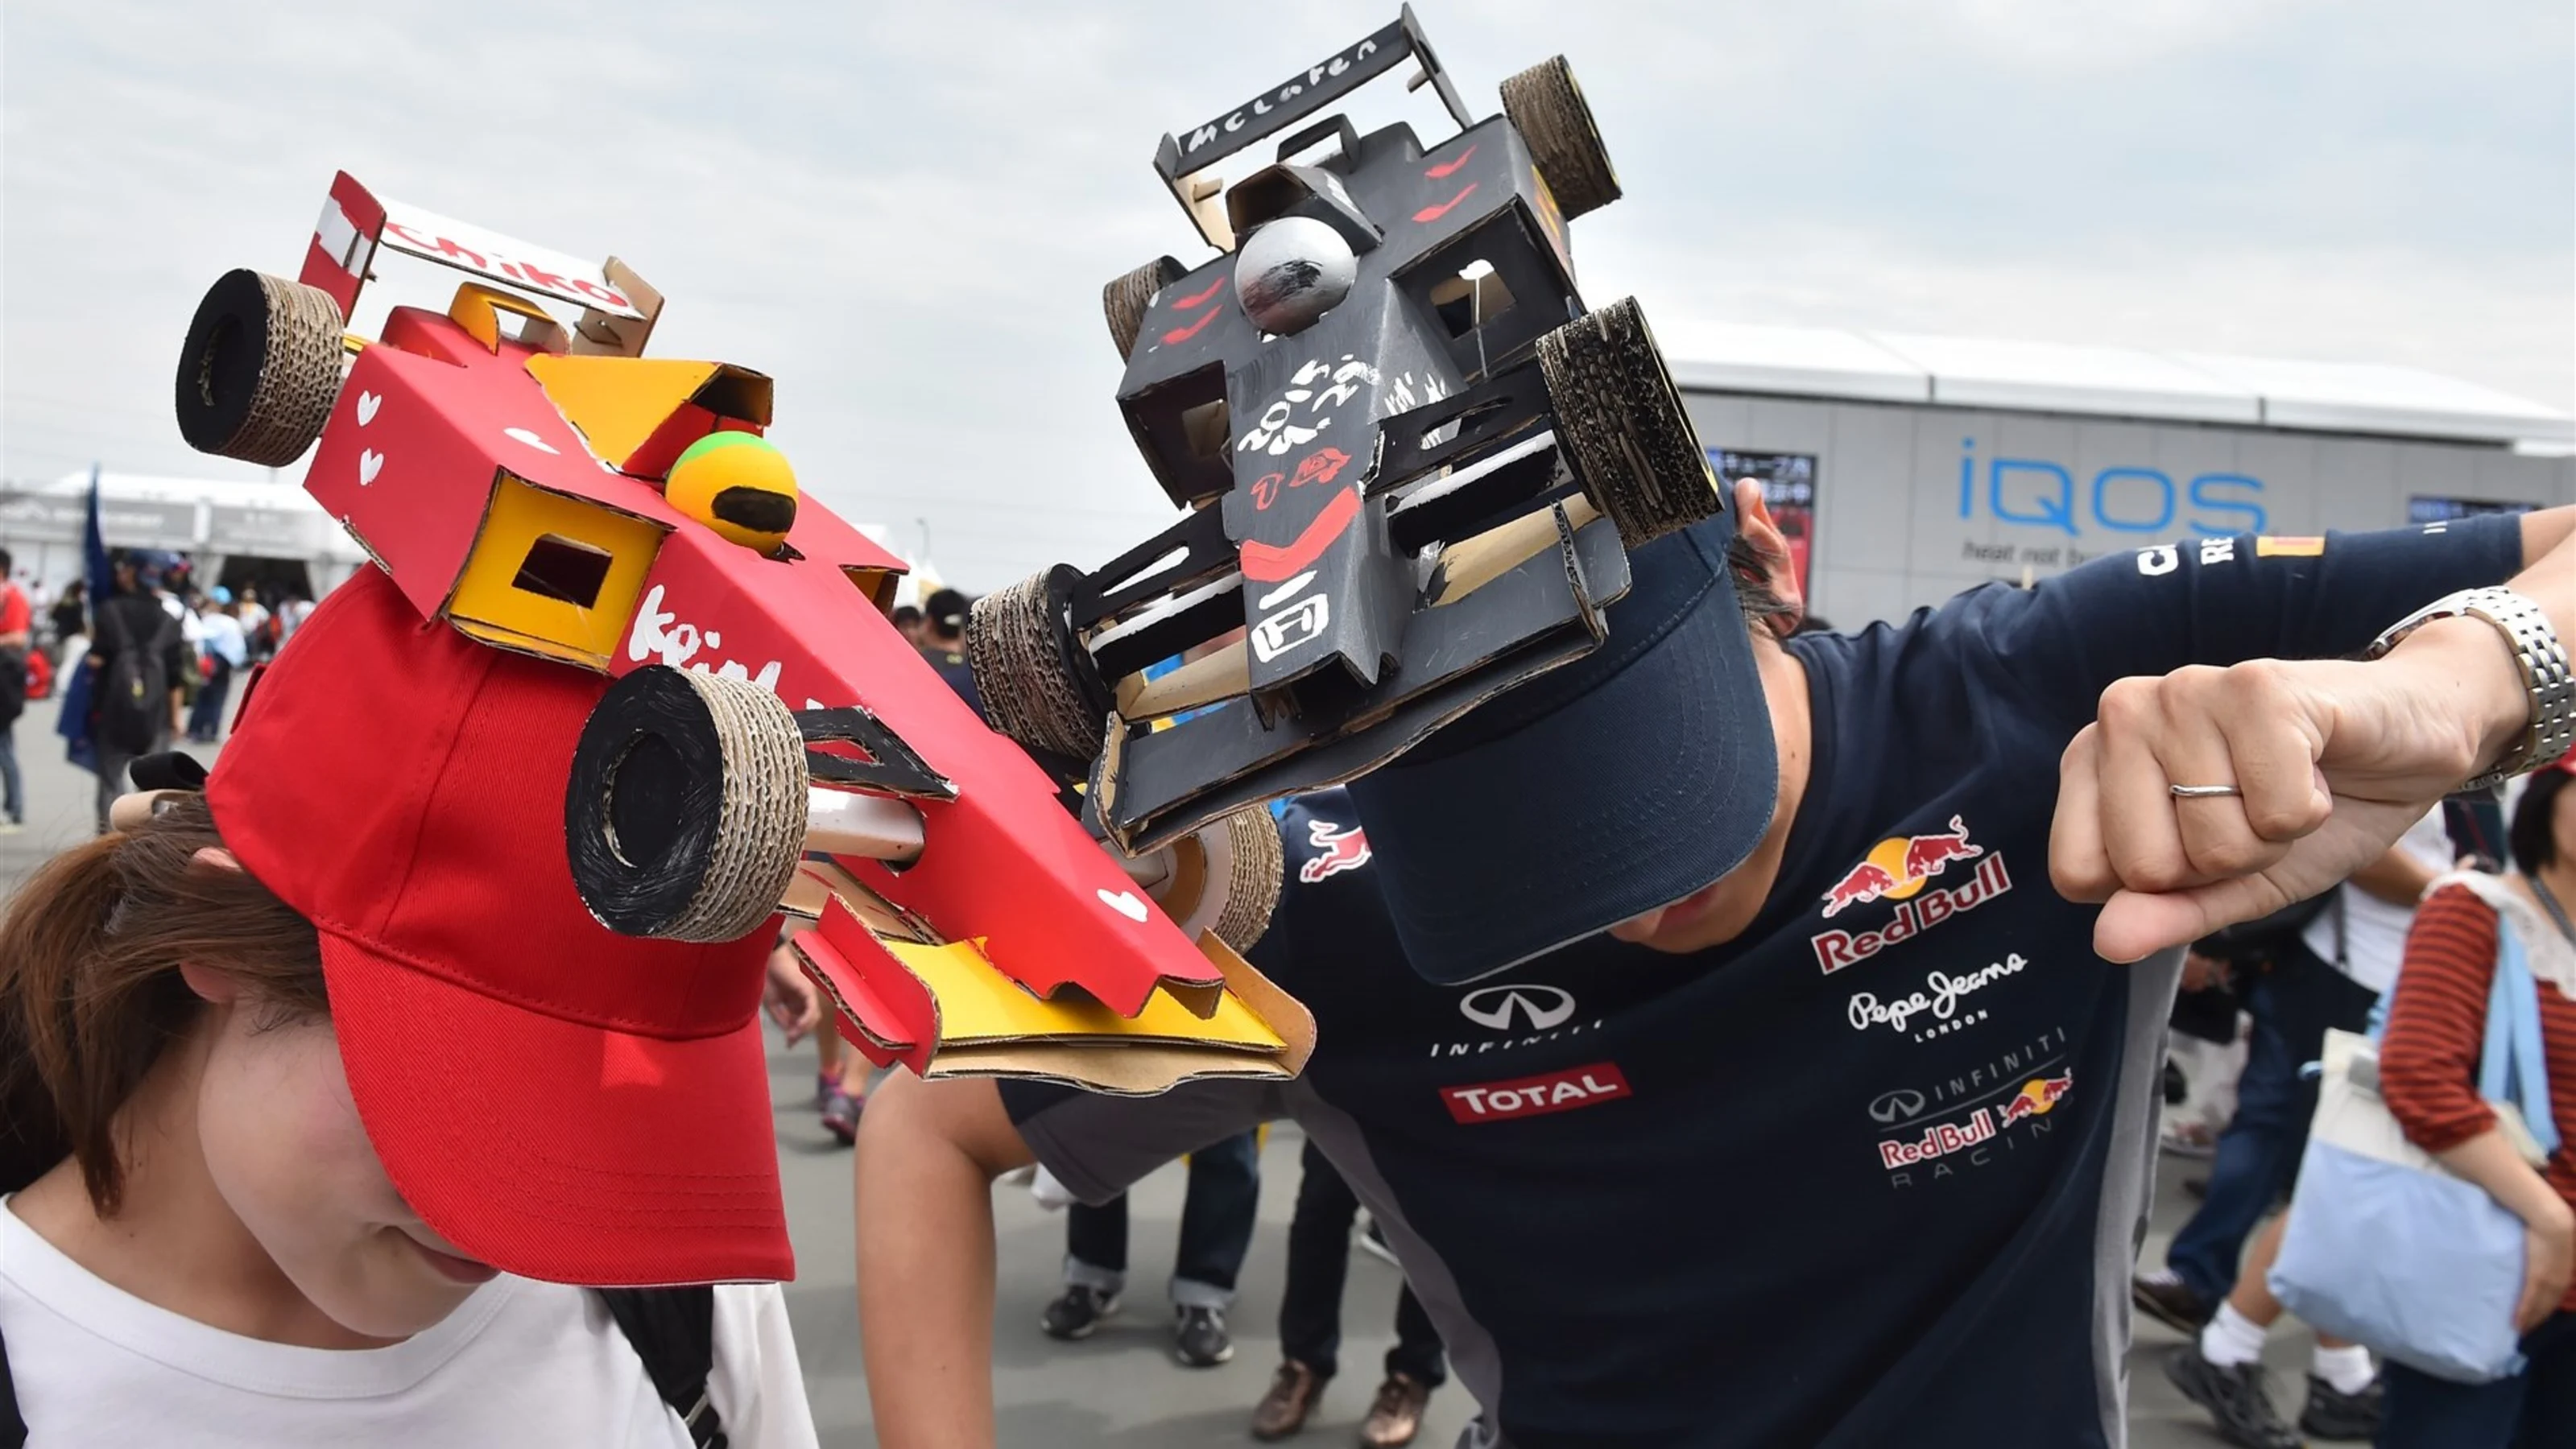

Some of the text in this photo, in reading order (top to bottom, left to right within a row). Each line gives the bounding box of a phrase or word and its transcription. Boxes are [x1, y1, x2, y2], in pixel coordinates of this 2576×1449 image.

[1957, 437, 2268, 537] iQOS
[1811, 850, 2013, 976] Red Bull
[1848, 952, 2028, 1033] Pepe Jeans
[1914, 1009, 1989, 1043] LONDON
[1453, 1075, 1618, 1114] TOTAL
[1934, 1026, 2066, 1101] INFINITI
[1878, 1107, 1997, 1170] Red Bull
